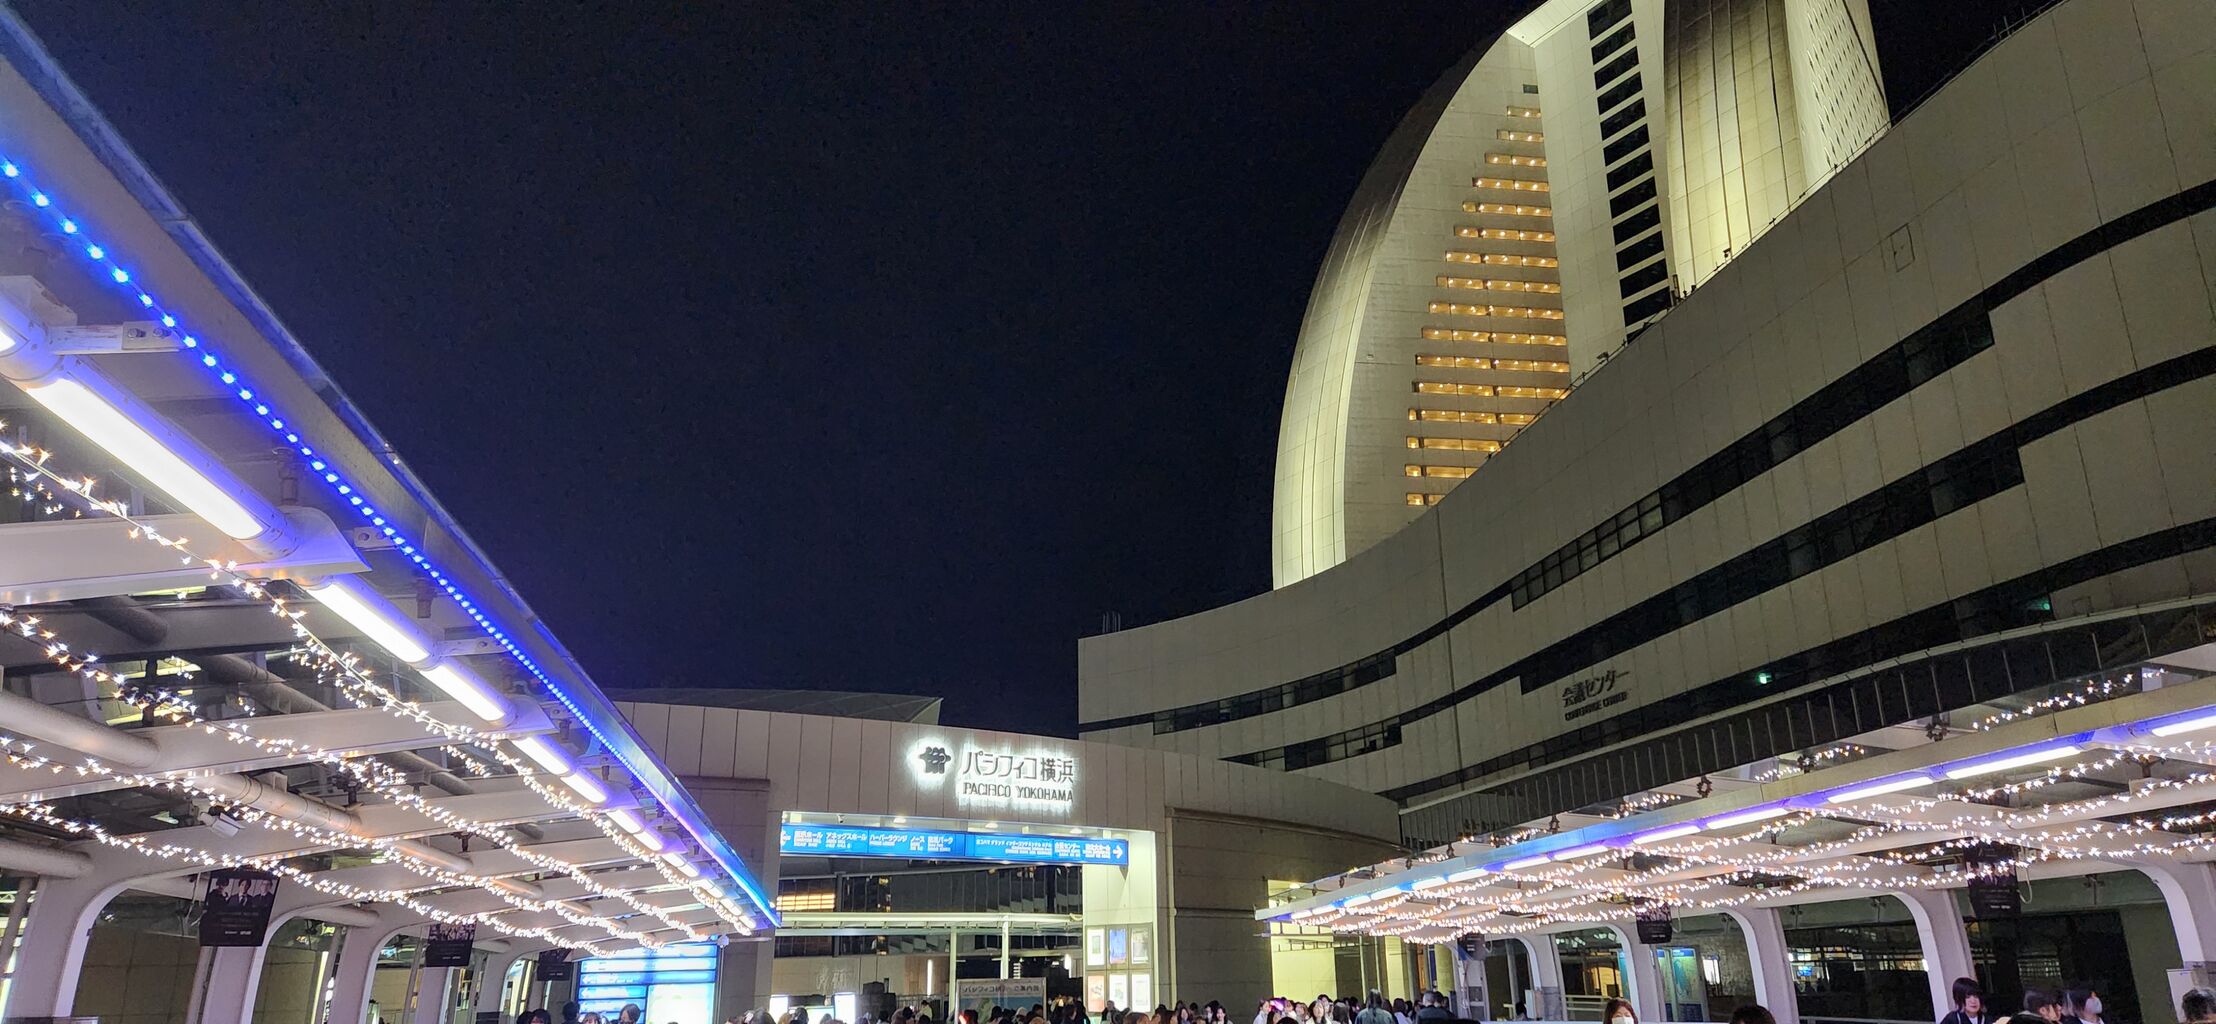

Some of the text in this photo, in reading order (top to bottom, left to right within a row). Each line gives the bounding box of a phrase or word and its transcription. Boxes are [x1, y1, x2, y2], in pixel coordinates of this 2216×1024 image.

[963, 750, 1074, 784] パシフィコ横浜
[963, 782, 1074, 802] PACIFICO YOKOHAMA
